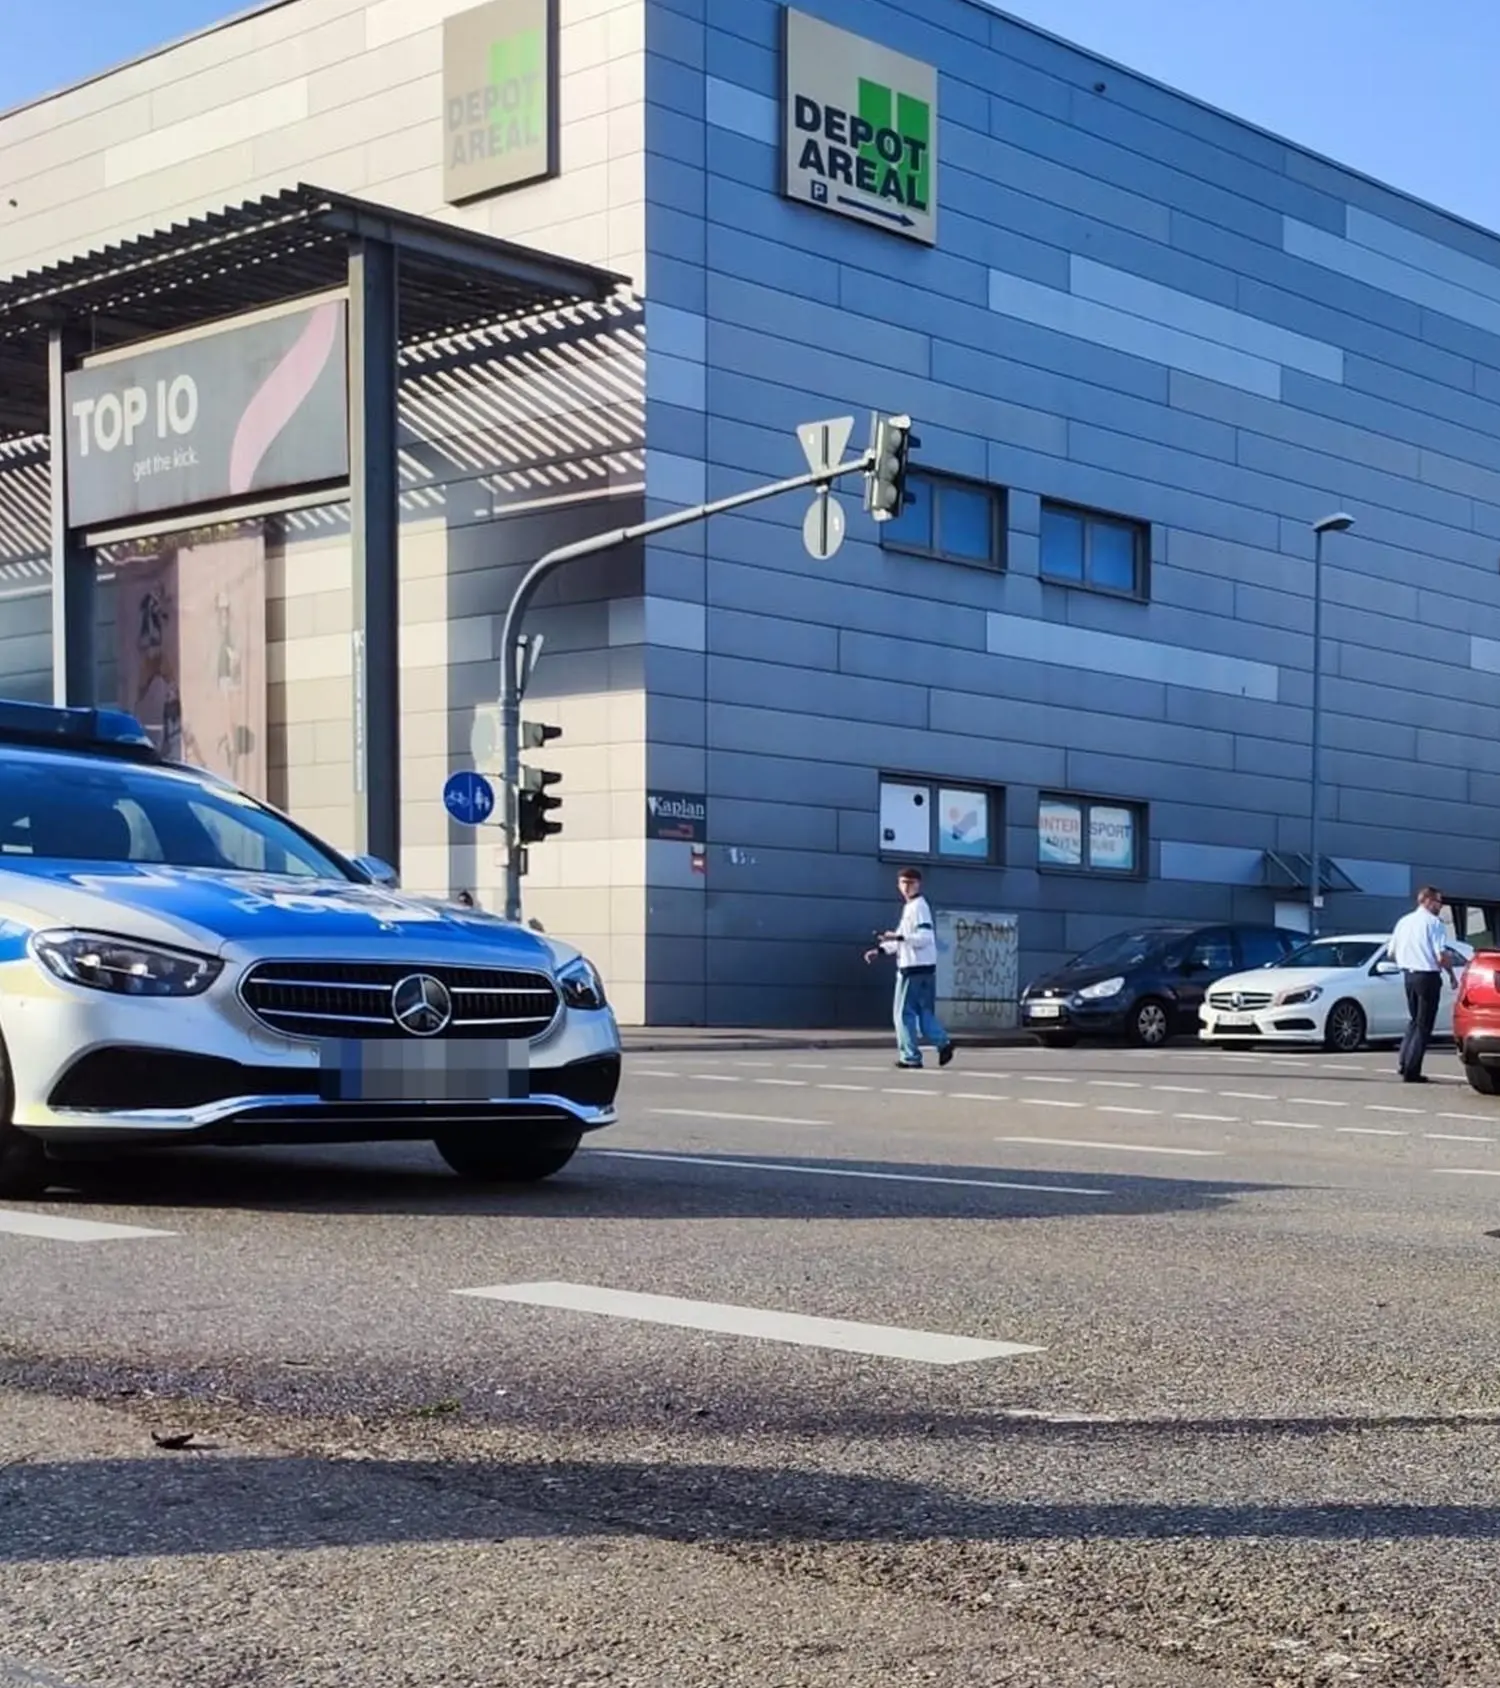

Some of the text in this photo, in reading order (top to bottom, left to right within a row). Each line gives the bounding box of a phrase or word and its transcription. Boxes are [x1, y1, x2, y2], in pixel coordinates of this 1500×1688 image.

[447, 72, 538, 132] DEPOT
[449, 115, 541, 171] AREAL
[795, 94, 926, 171] DEPOT
[798, 138, 927, 211] AREAL
[72, 373, 198, 457] TOP 10
[133, 456, 151, 482] get
[153, 453, 171, 474] the
[648, 796, 704, 819] Kaplan
